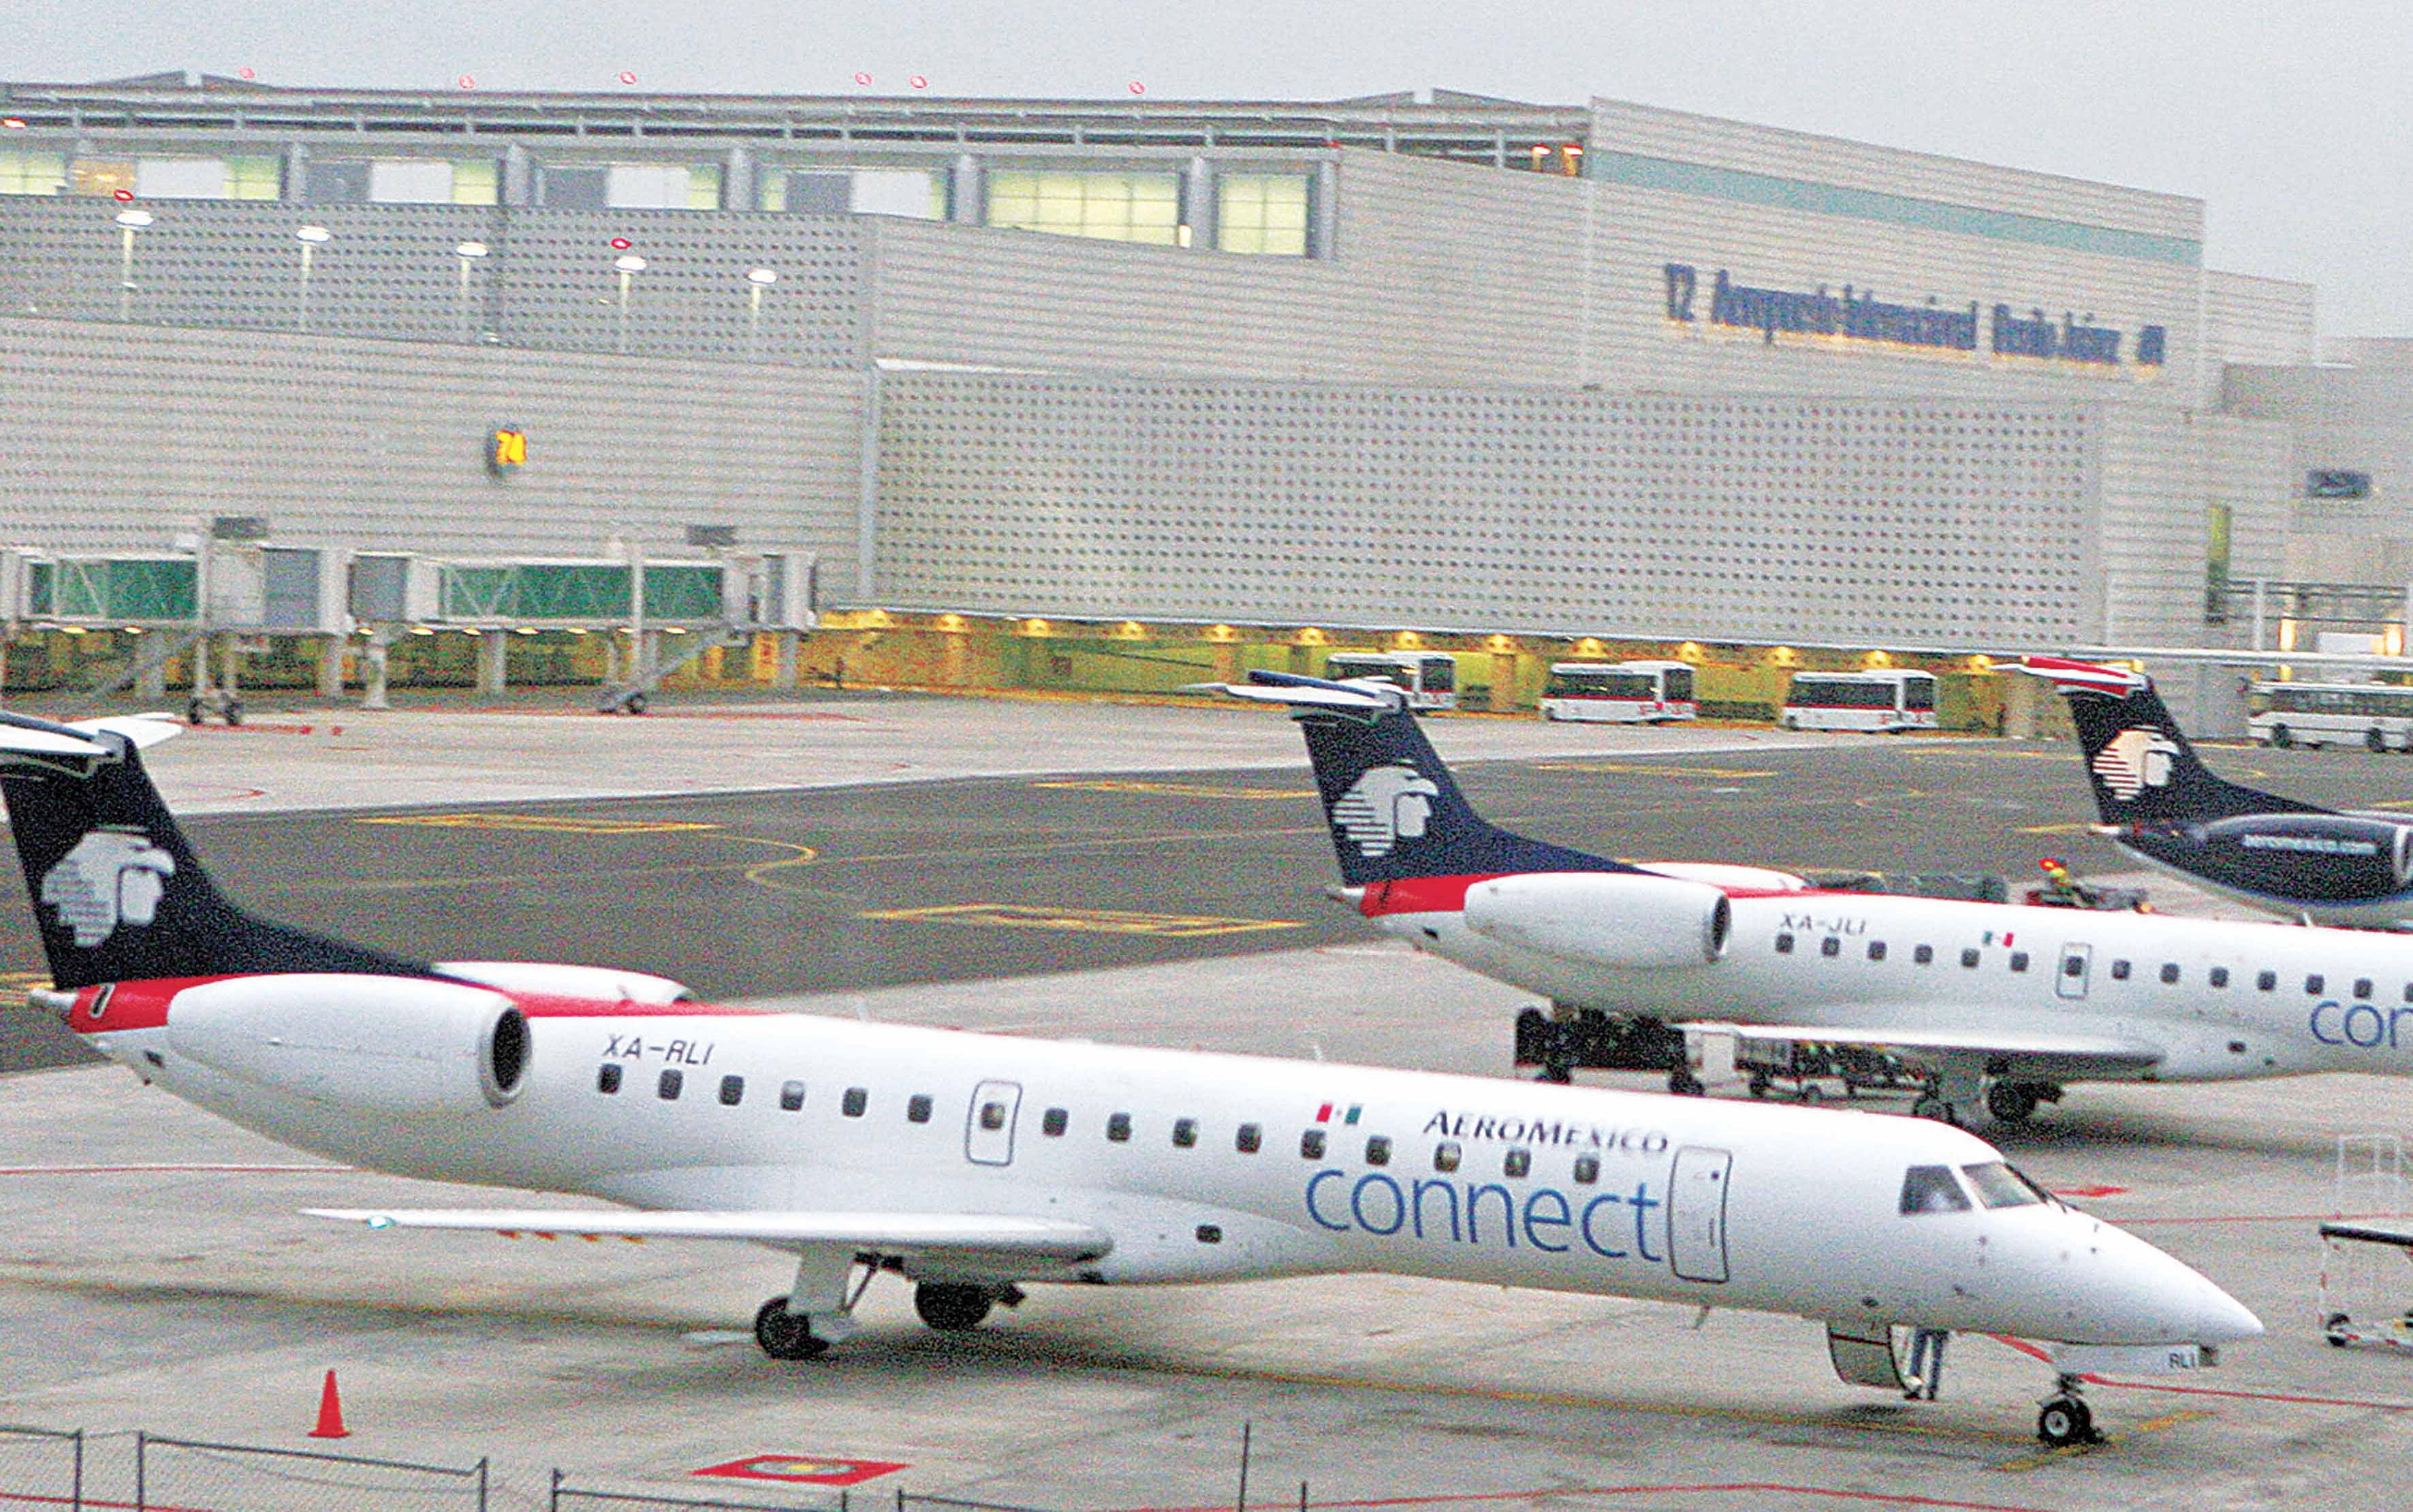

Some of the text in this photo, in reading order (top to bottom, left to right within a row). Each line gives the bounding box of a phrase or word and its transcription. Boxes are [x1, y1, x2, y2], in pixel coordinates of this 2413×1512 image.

[602, 1033, 714, 1065] XA-RLI
[1423, 1110, 1667, 1154] AEROMEXICO
[1306, 1169, 1662, 1262] connect
